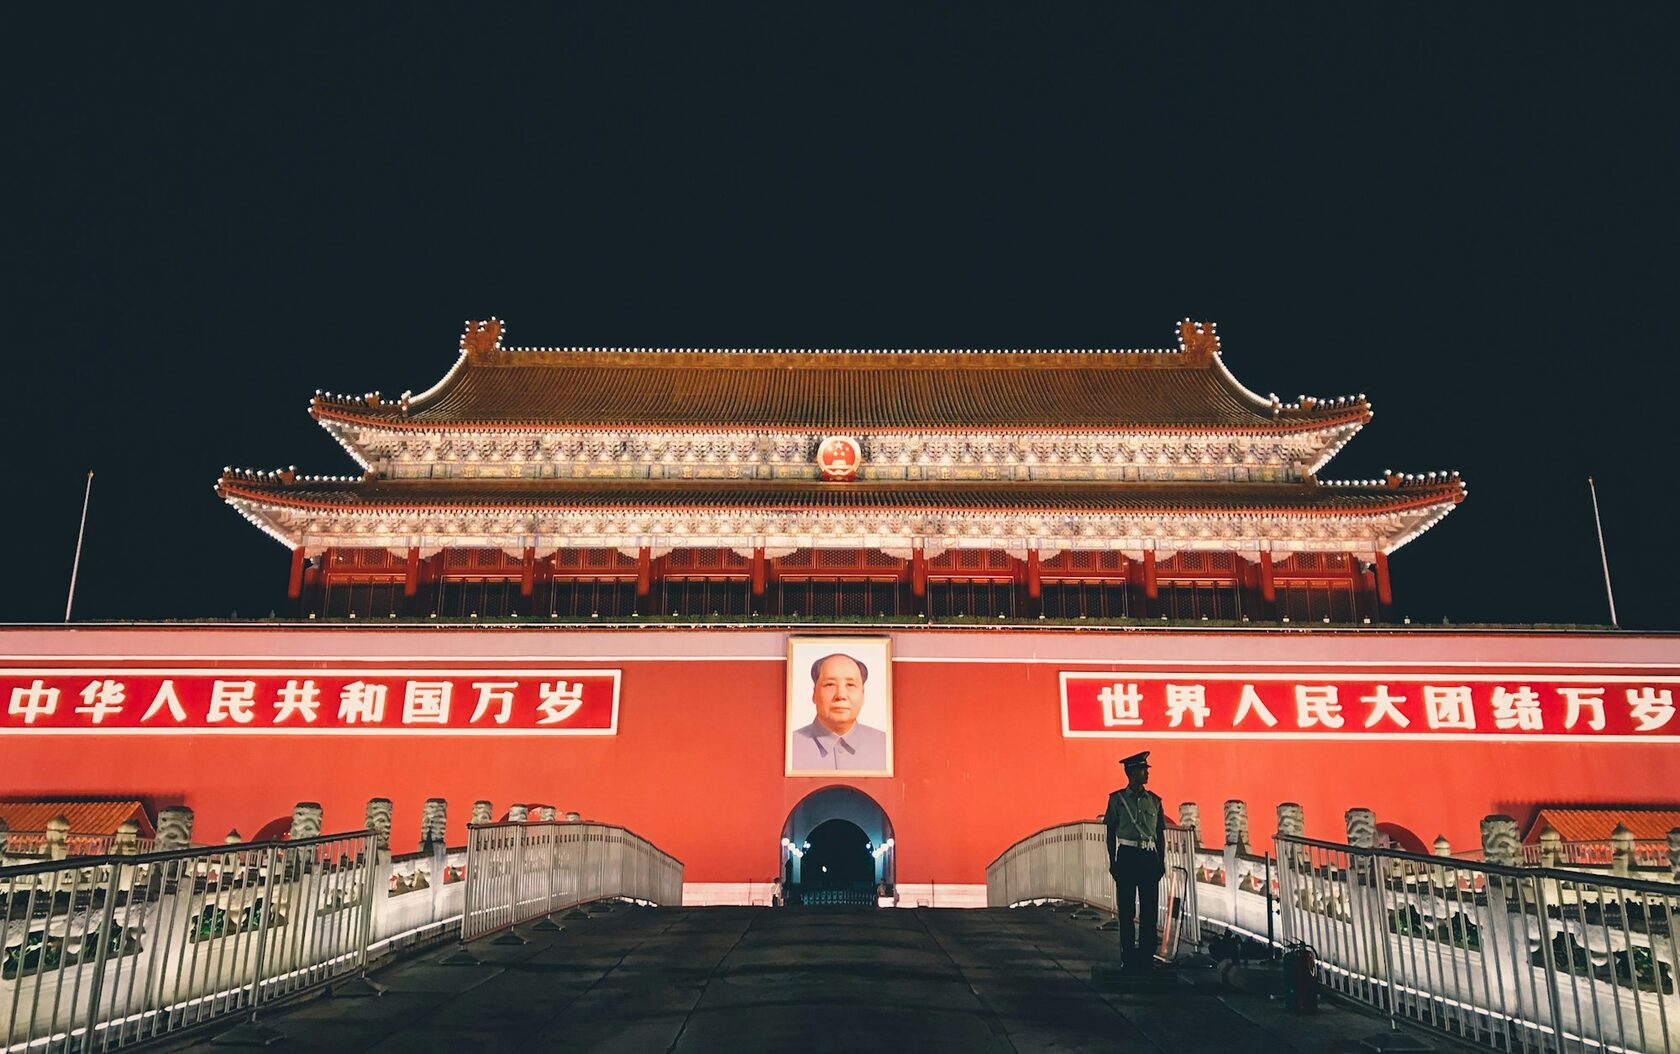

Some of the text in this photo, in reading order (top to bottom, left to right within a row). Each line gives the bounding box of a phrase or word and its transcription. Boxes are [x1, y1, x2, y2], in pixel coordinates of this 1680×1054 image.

[7, 679, 584, 724] 中华人民共和国万岁
[1097, 683, 1677, 731] 世界人民大团结万岁
